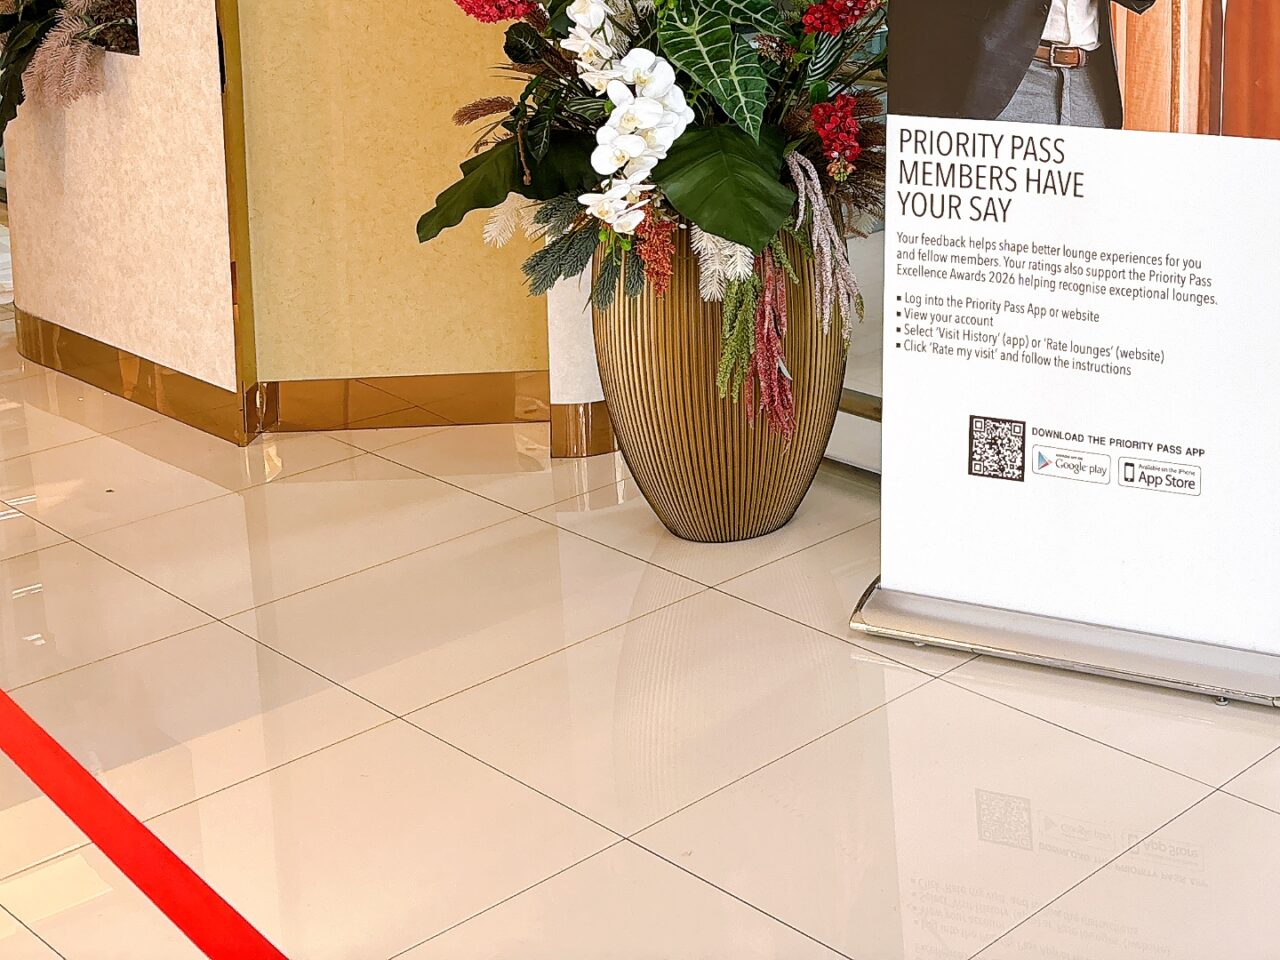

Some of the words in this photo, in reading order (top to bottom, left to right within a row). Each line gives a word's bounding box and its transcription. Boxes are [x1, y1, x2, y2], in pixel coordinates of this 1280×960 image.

[899, 128, 1004, 158] PRIORITY
[1010, 134, 1064, 164] PASS
[899, 159, 1017, 192] MEMBERS
[1026, 168, 1084, 198] HAVE
[896, 190, 961, 219] YOUR
[969, 195, 1012, 222] SAY
[896, 231, 918, 244] Your
[920, 233, 965, 247] feedback
[968, 236, 996, 252] helps
[998, 239, 1028, 255] shape
[1031, 241, 1060, 256] better
[1062, 244, 1097, 262] lounge
[1099, 251, 1162, 265] experiences
[1165, 252, 1179, 267] for
[1182, 258, 1201, 270] you
[896, 248, 915, 260] and
[917, 248, 947, 262] fellow
[950, 254, 1000, 267] members.
[1002, 256, 1025, 269] Your
[1028, 259, 1061, 275] ratings
[1063, 261, 1083, 275] also
[1085, 267, 1125, 280] support
[1128, 267, 1145, 281] the
[1148, 269, 1186, 287] Priority
[1189, 273, 1211, 287] Pass
[896, 263, 947, 279] Excellence
[949, 267, 985, 282] Awards
[988, 271, 1015, 284] 2026
[1018, 273, 1055, 292] helping
[1058, 280, 1106, 295] recognise
[1108, 285, 1169, 300] exceptional
[1172, 287, 1217, 305] lounges.
[903, 307, 927, 320] View
[929, 312, 952, 325] your
[954, 314, 993, 326] account
[904, 291, 921, 307] Log
[924, 293, 943, 306] into
[946, 296, 963, 308] the
[965, 297, 1001, 314] Priority
[1003, 301, 1024, 313] Pass
[1026, 303, 1046, 319] App
[1049, 307, 1059, 317] or
[1061, 307, 1099, 322] website
[903, 323, 933, 337] Select
[1002, 333, 1029, 351] (app)
[1031, 338, 1041, 348] or
[1115, 345, 1164, 364] (website)
[903, 339, 926, 352] Click
[956, 347, 972, 360] my
[1000, 351, 1018, 362] and
[1021, 351, 1051, 365] follow
[1053, 355, 1069, 368] the
[1072, 357, 1131, 375] instructions
[1031, 426, 1084, 442] DOWNLOAD
[1087, 434, 1105, 445] THE
[1109, 437, 1153, 451] PRIORITY
[1156, 443, 1181, 454] PASS
[1185, 447, 1205, 457] APP
[1054, 458, 1088, 474] Google
[1089, 464, 1107, 477] play
[1138, 471, 1163, 487] App
[1164, 474, 1195, 489] Store
